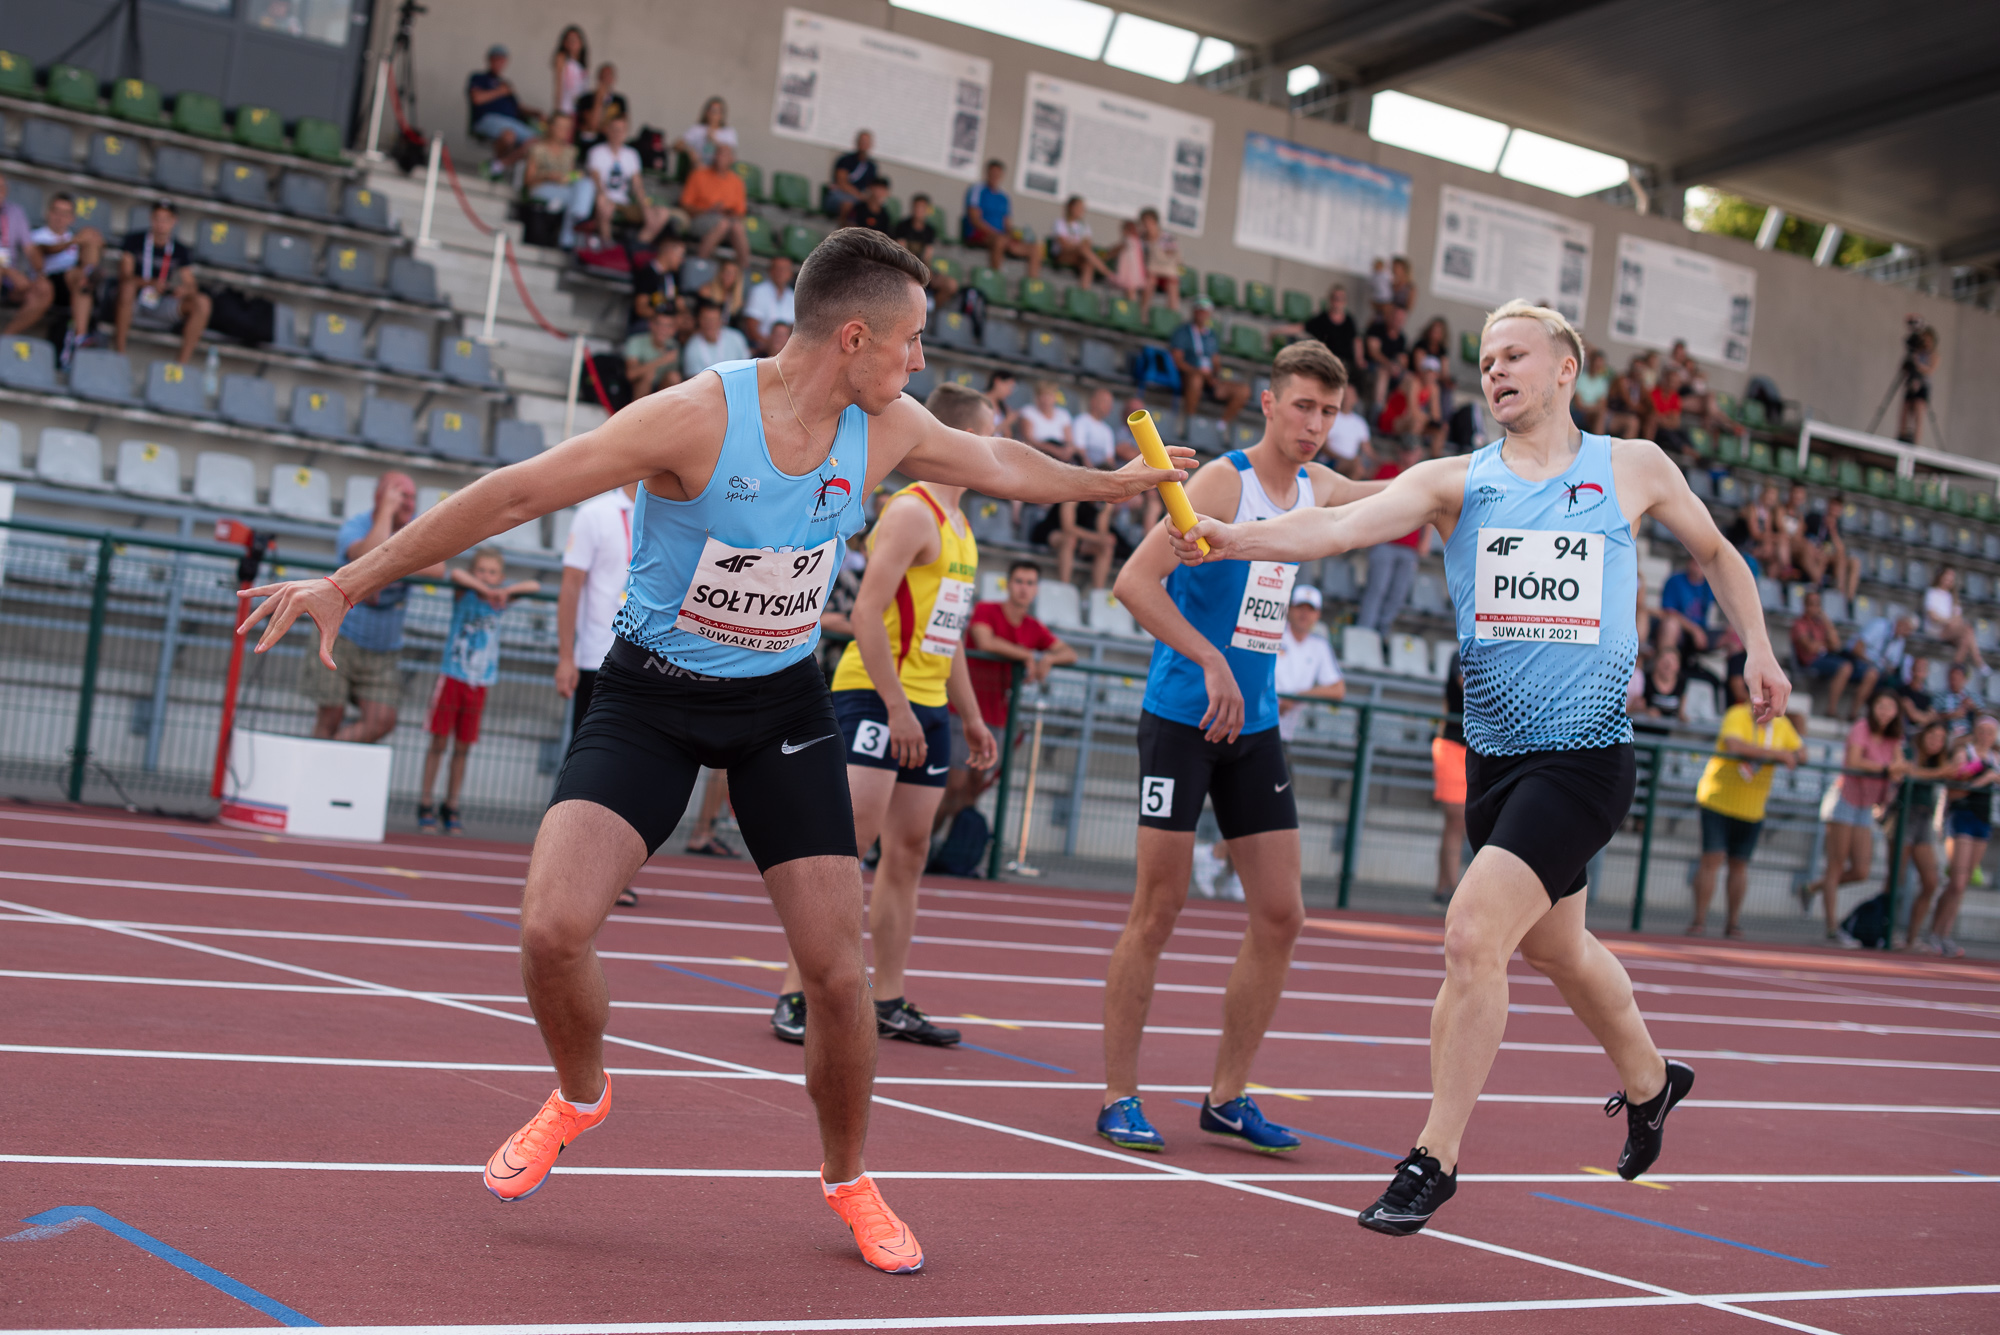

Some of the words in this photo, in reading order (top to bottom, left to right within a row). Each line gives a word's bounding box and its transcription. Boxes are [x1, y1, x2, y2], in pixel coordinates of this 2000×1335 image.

[1486, 536, 1524, 556] 4F
[1554, 536, 1588, 561] 94
[714, 554, 762, 573] 4F
[791, 549, 824, 579] 97
[1494, 572, 1580, 602] PIÓRO
[693, 584, 822, 617] SOŁTYSIAK
[720, 623, 775, 636] MISTRZOSTWA
[776, 628, 801, 636] POLSKI
[1505, 615, 1555, 623] MISTRZOSTWA
[698, 626, 761, 649] SUWAŁKI
[764, 638, 795, 651] 2021
[1492, 626, 1545, 639] SUWAŁKI
[1548, 628, 1578, 640] 2021
[862, 725, 881, 752] 3
[1147, 781, 1164, 813] 5
